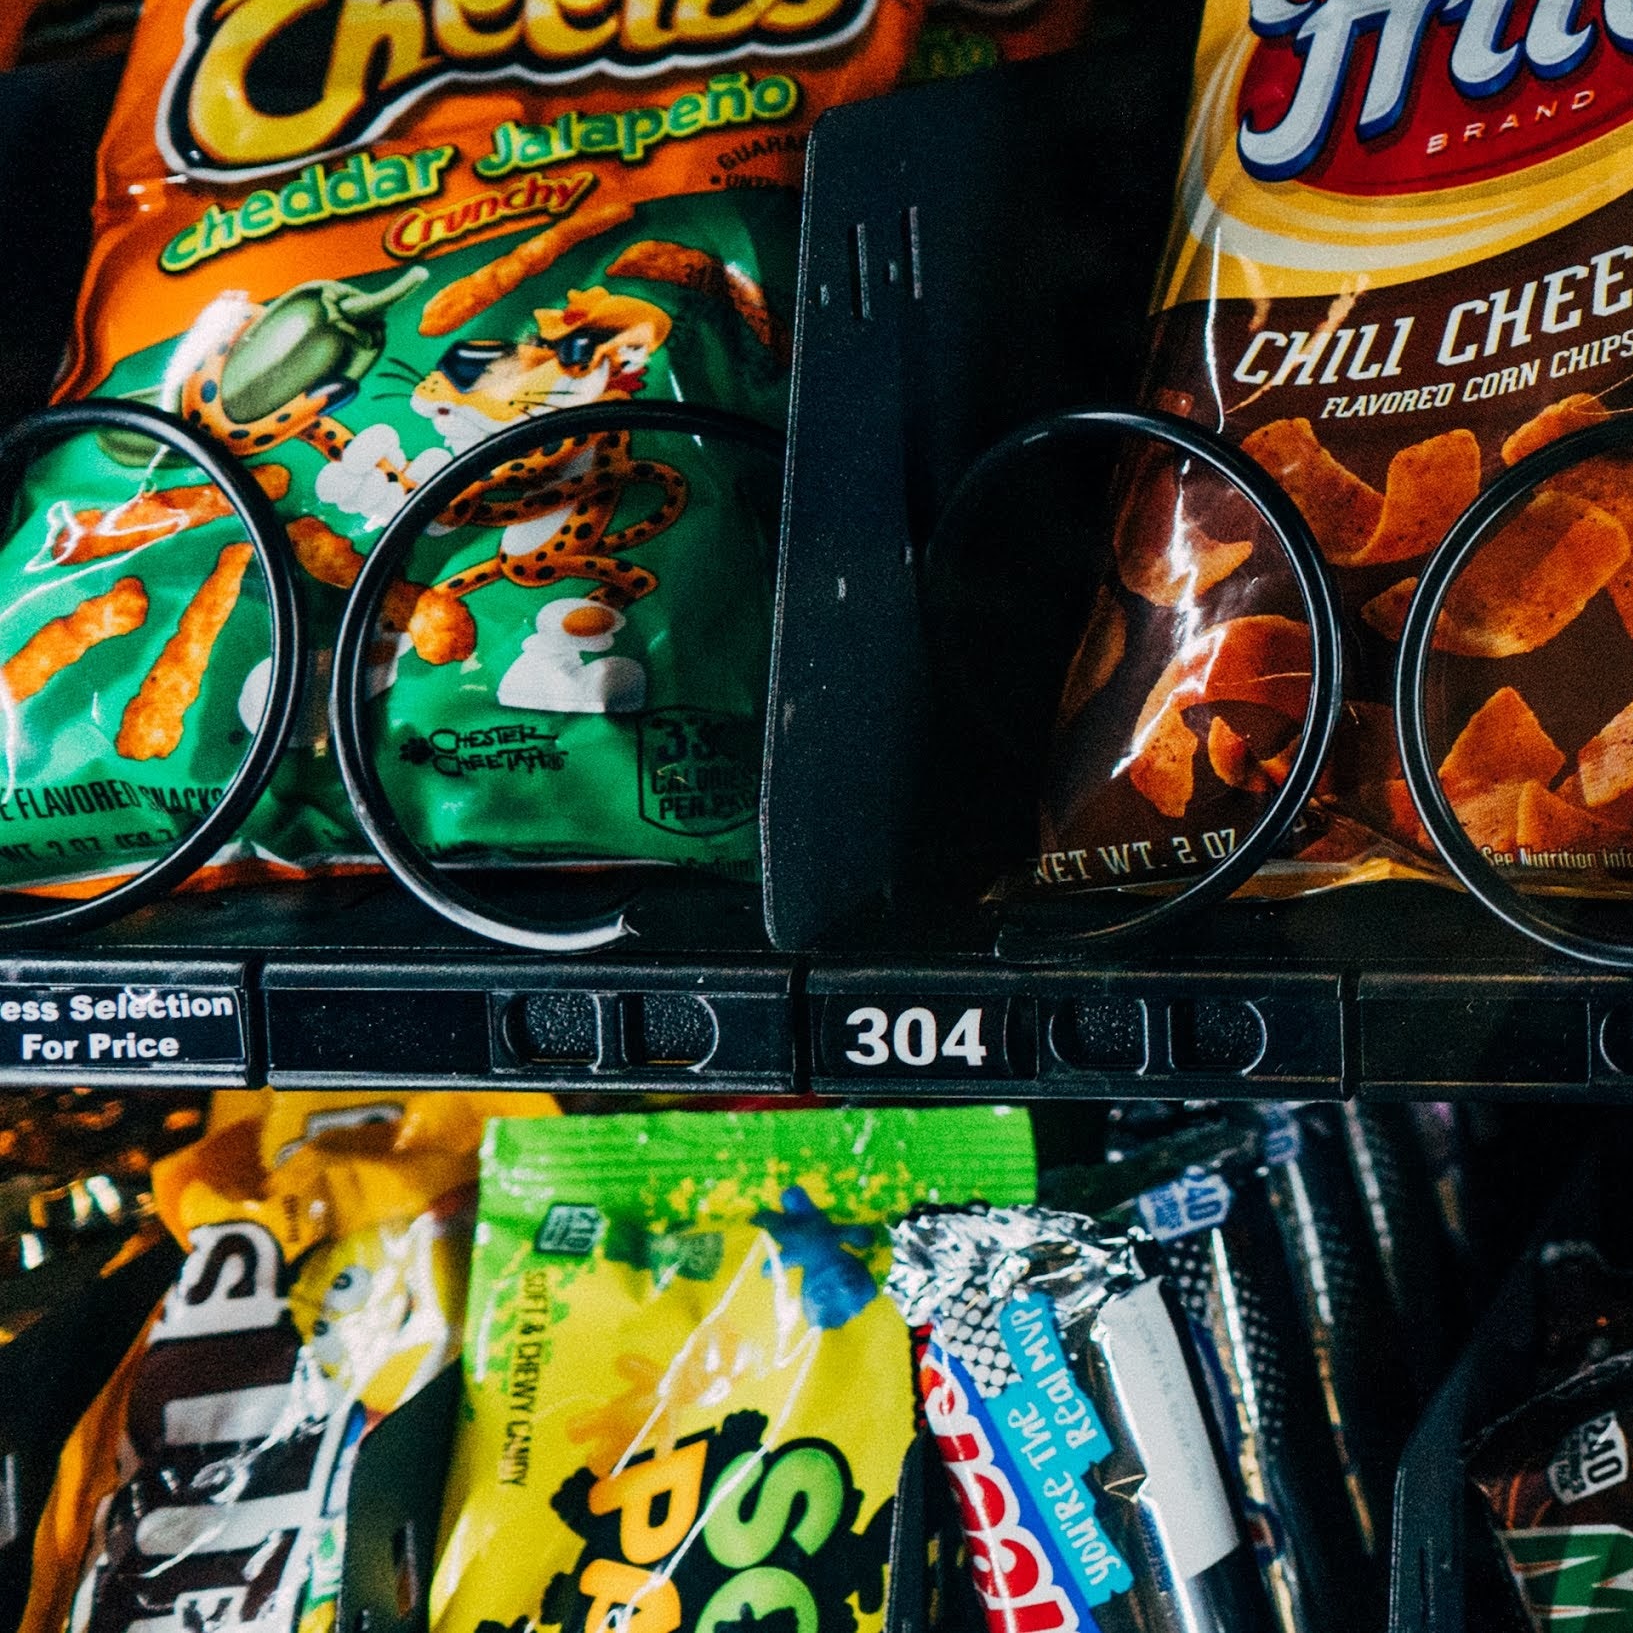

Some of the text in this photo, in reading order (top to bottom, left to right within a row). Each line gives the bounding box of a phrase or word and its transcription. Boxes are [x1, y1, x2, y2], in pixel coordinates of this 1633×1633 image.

[1424, 88, 1596, 156] BRAND
[162, 71, 800, 270] cheddar Jalapeño
[385, 172, 594, 259] Crunchy
[1231, 315, 1416, 387] CHILI
[1319, 379, 1451, 423] FLAVORED
[1461, 359, 1538, 402] CORN
[429, 723, 558, 754] CHESTER
[432, 745, 550, 777] CHEETAH
[14, 778, 140, 823] FLAVORED
[1034, 848, 1093, 886] NET
[1172, 836, 1198, 865] 2
[1519, 845, 1597, 869] Nutrition
[87, 988, 235, 1023] Selection
[21, 1033, 181, 1061] For Price
[845, 1007, 987, 1067] 304
[511, 1271, 548, 1414] SOFT CHEWY
